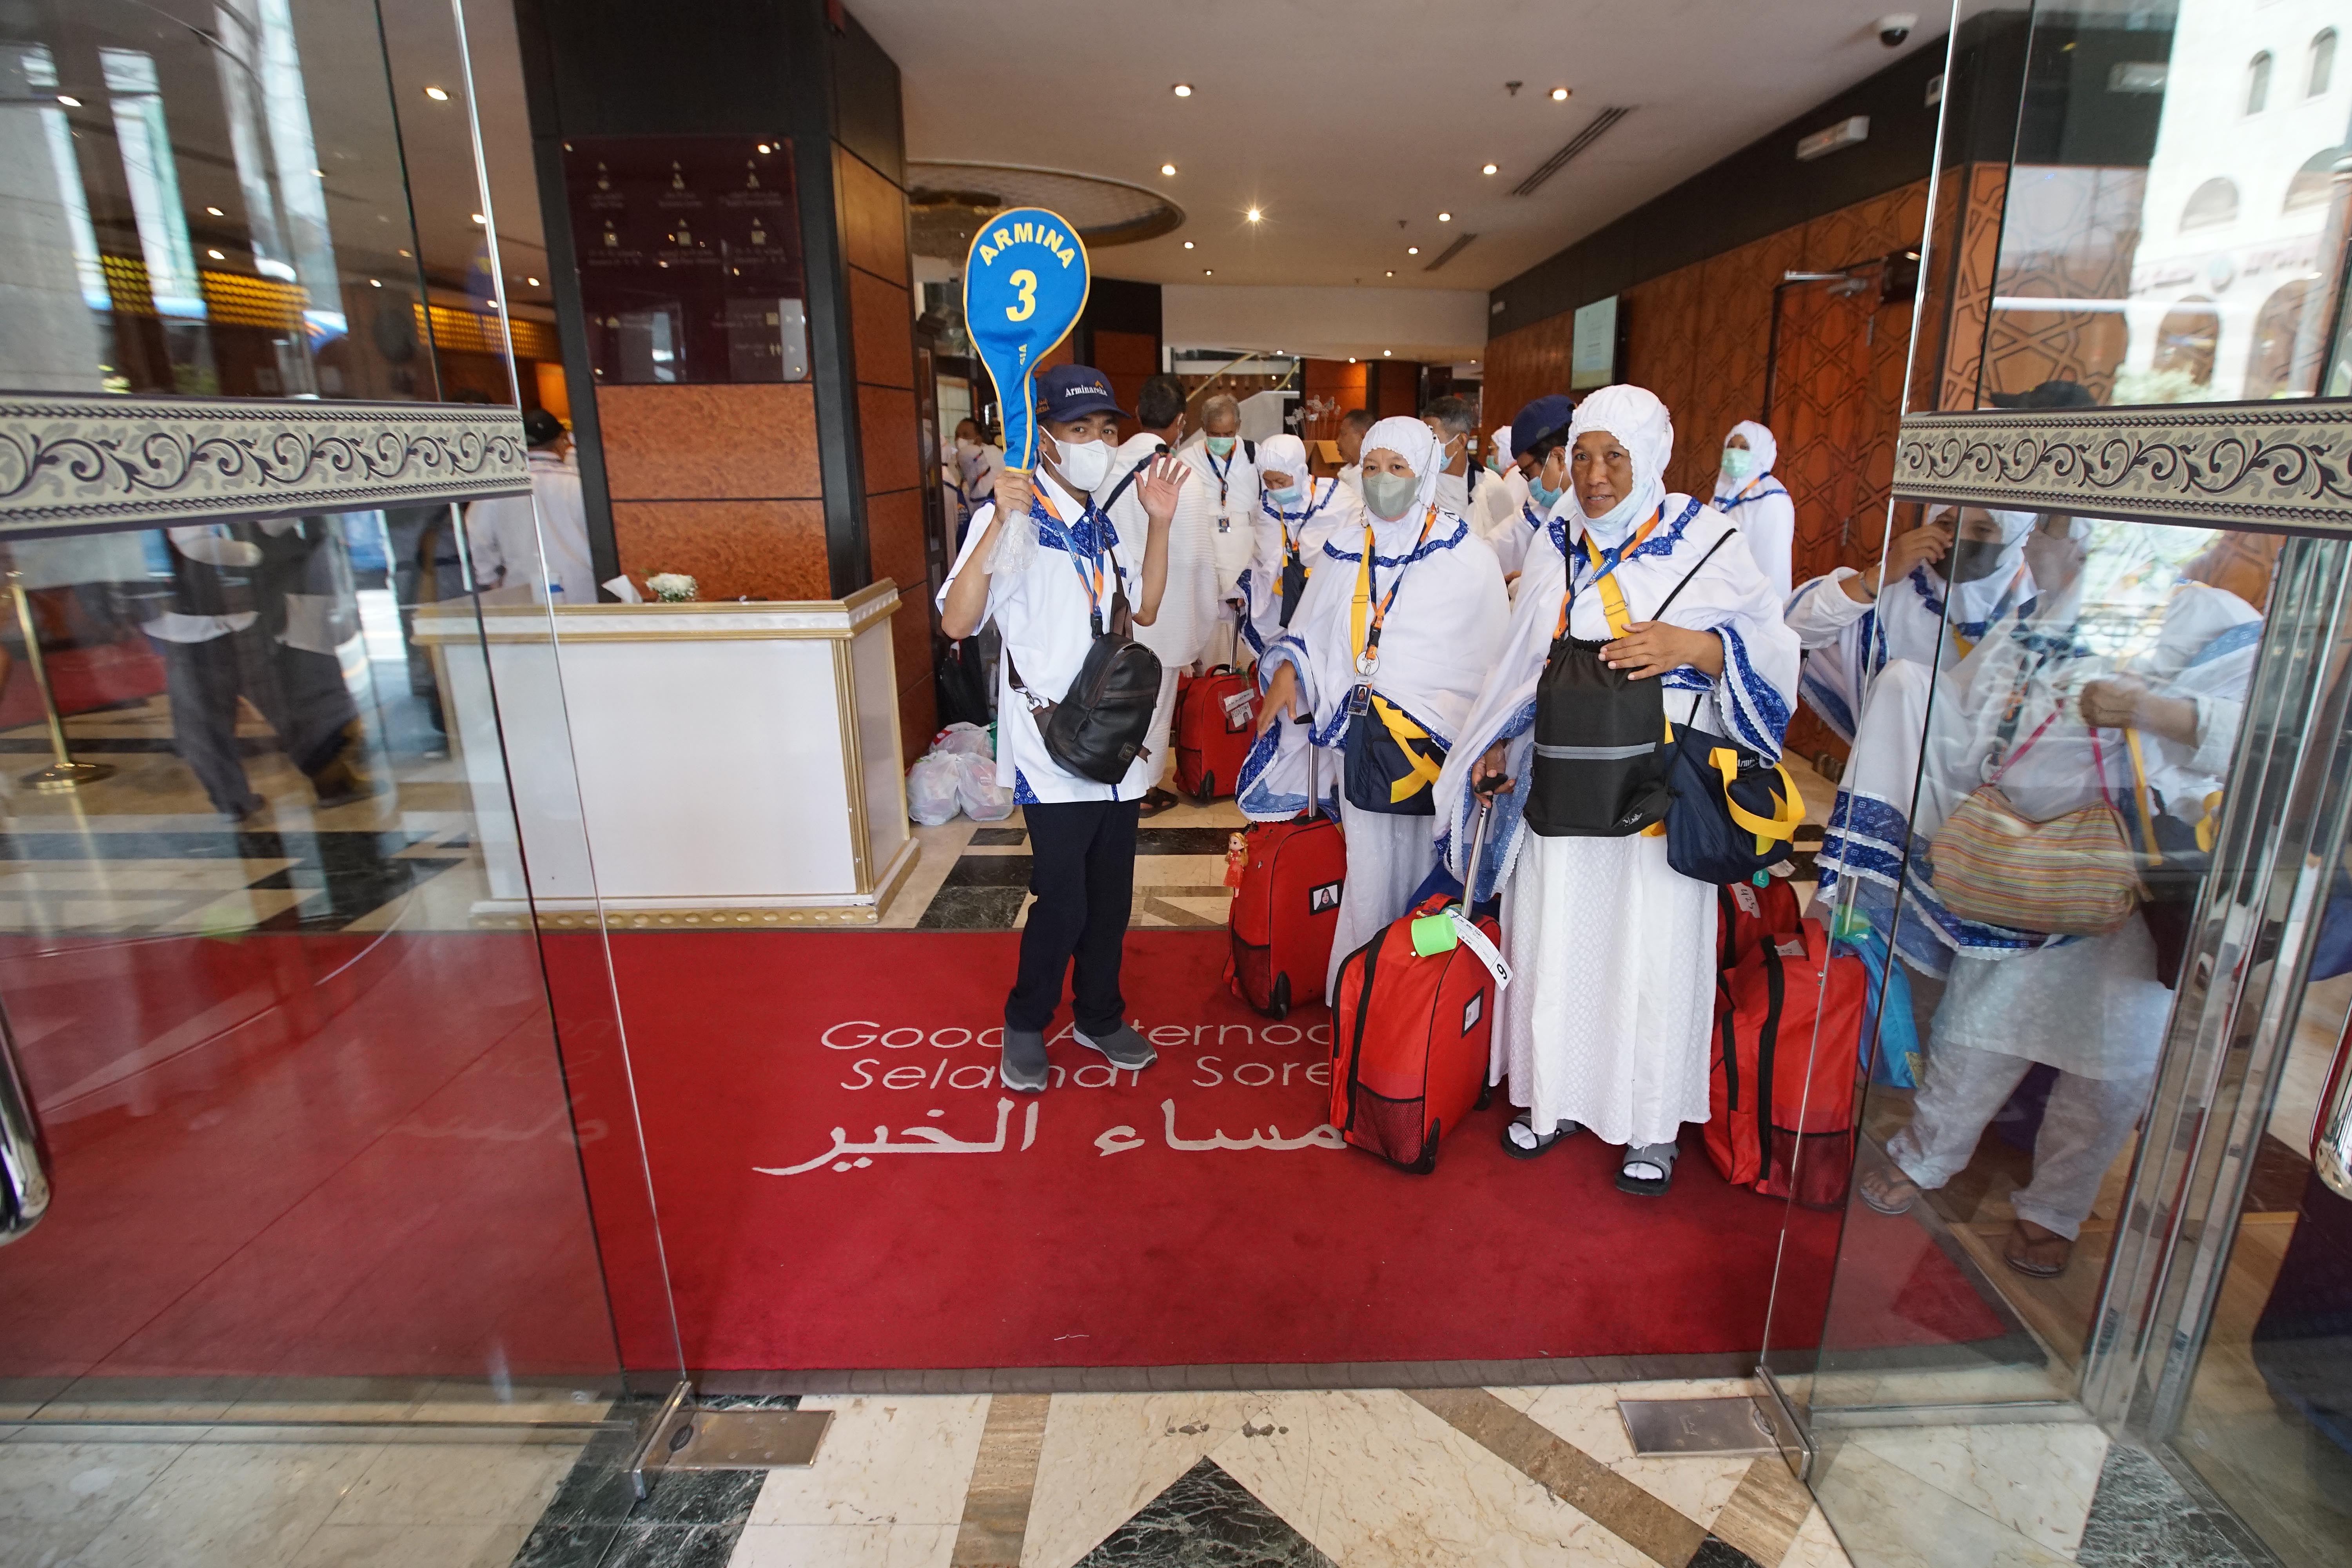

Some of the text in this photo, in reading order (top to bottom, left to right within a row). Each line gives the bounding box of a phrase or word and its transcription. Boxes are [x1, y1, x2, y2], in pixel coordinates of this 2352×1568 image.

[979, 222, 1075, 269] ARMINA
[1005, 269, 1037, 322] 3
[1065, 385, 1108, 397] Arminareka
[752, 1097, 1347, 1176] مساء الخير
